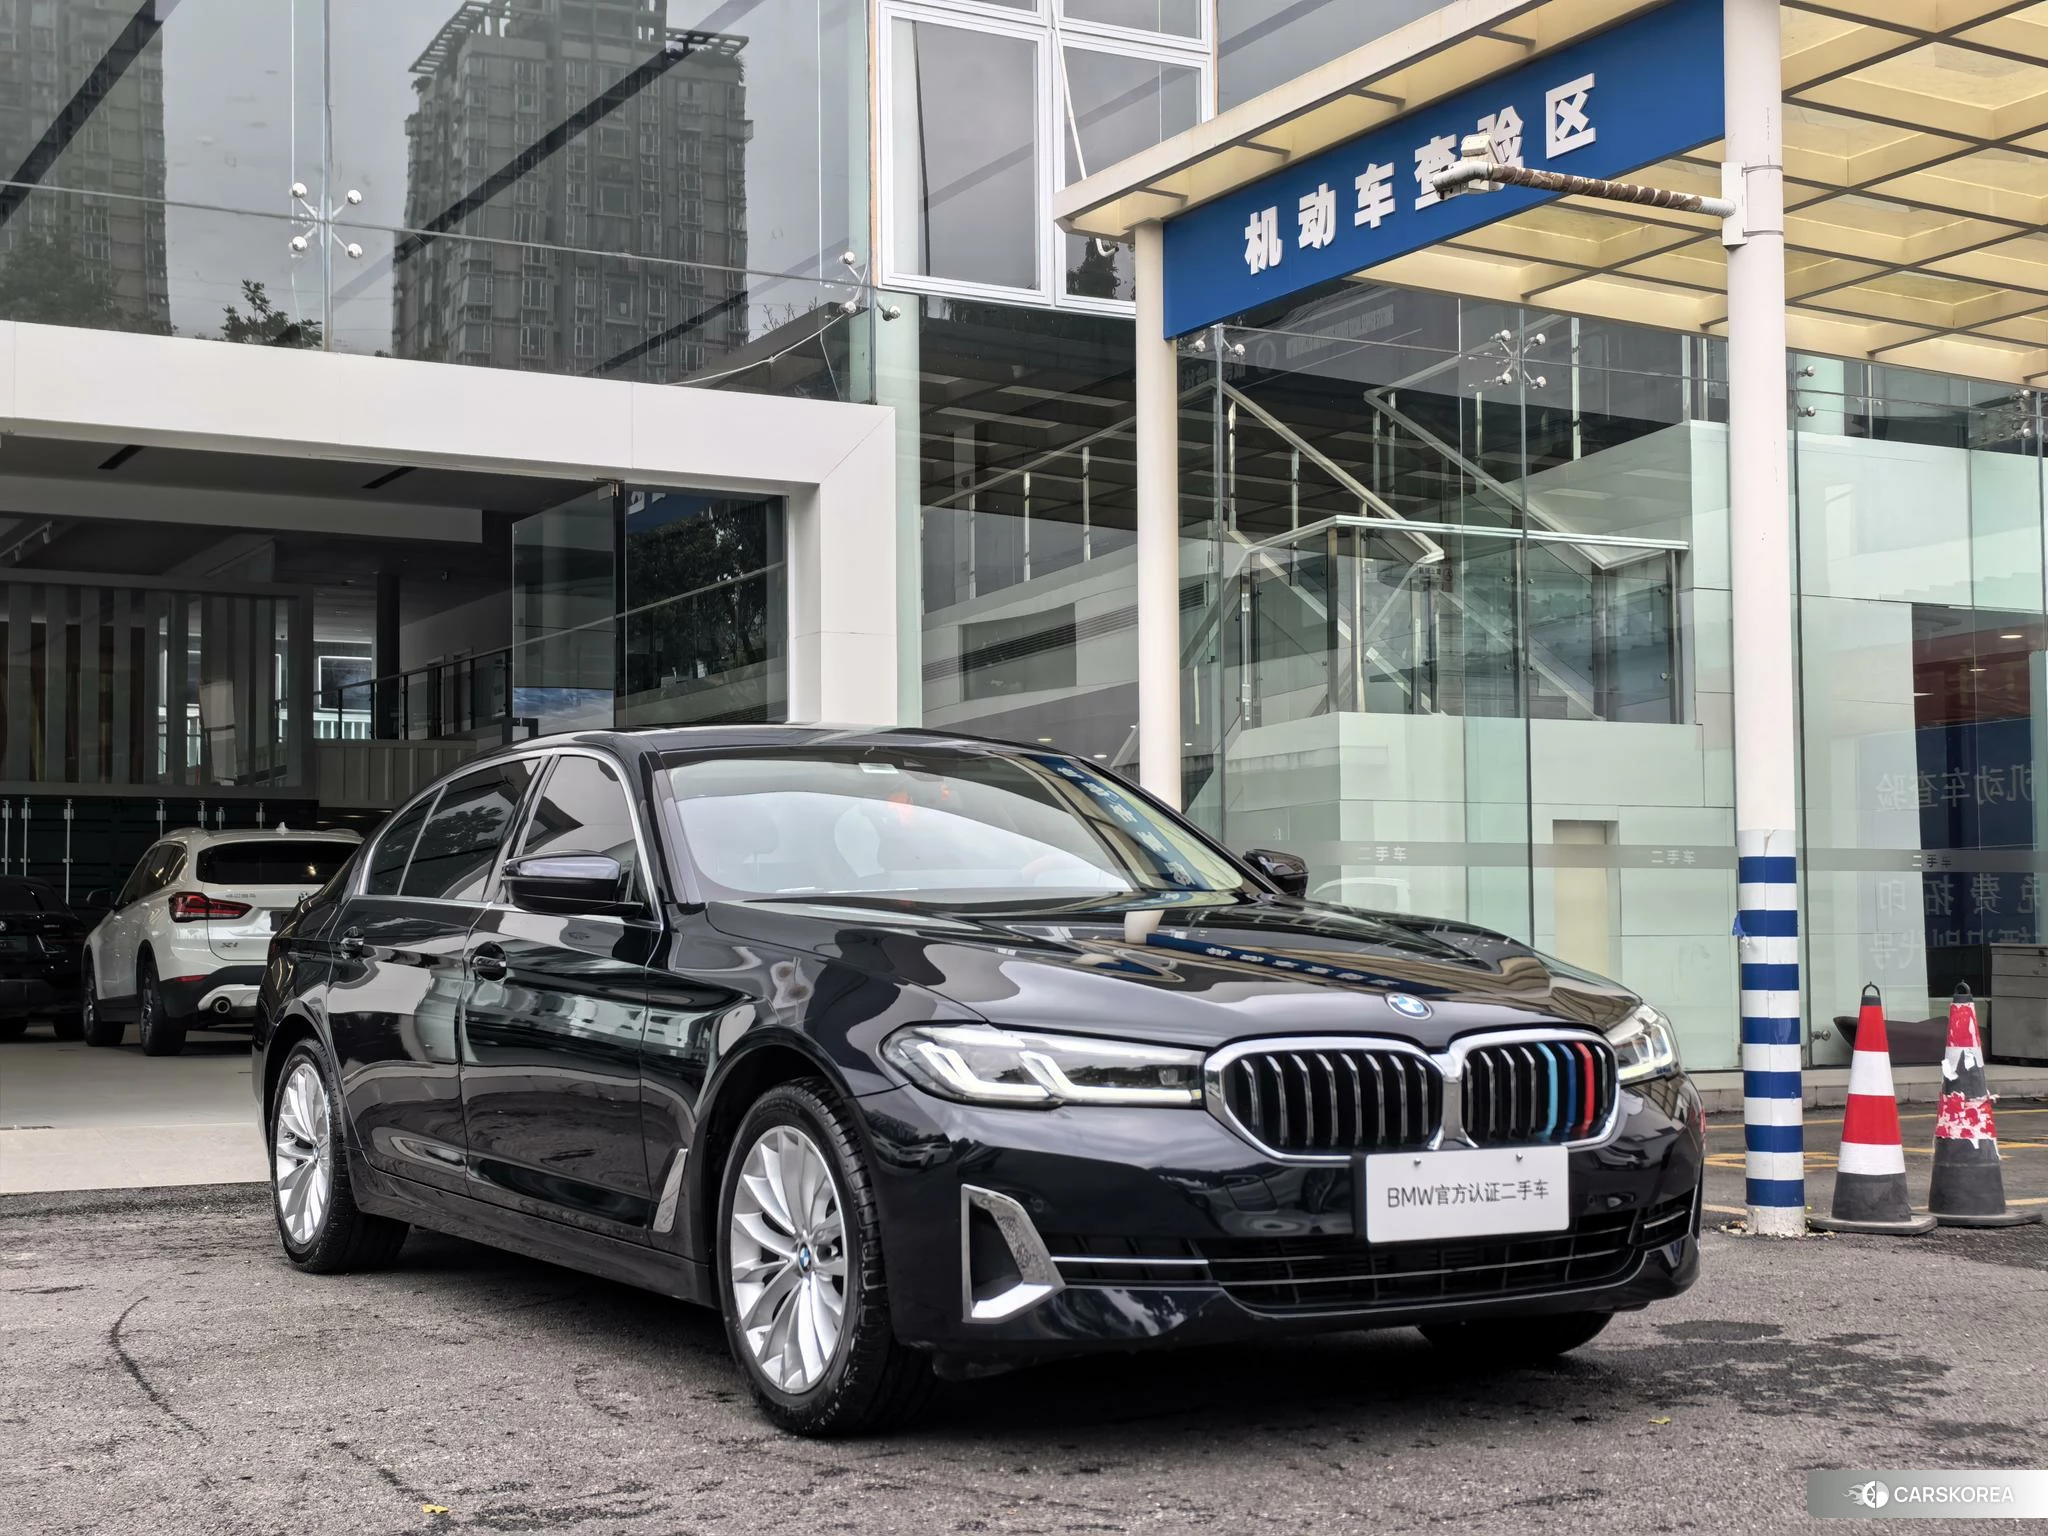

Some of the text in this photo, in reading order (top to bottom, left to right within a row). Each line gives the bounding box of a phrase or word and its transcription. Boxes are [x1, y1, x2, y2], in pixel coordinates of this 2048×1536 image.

[1244, 73, 1597, 276] 机动车查验区
[1357, 844, 1408, 862] 二手车
[1651, 849, 1697, 865] 二手车
[1911, 854, 1953, 869] 二手车
[1387, 1178, 1550, 1208] BMW官方认证二手车
